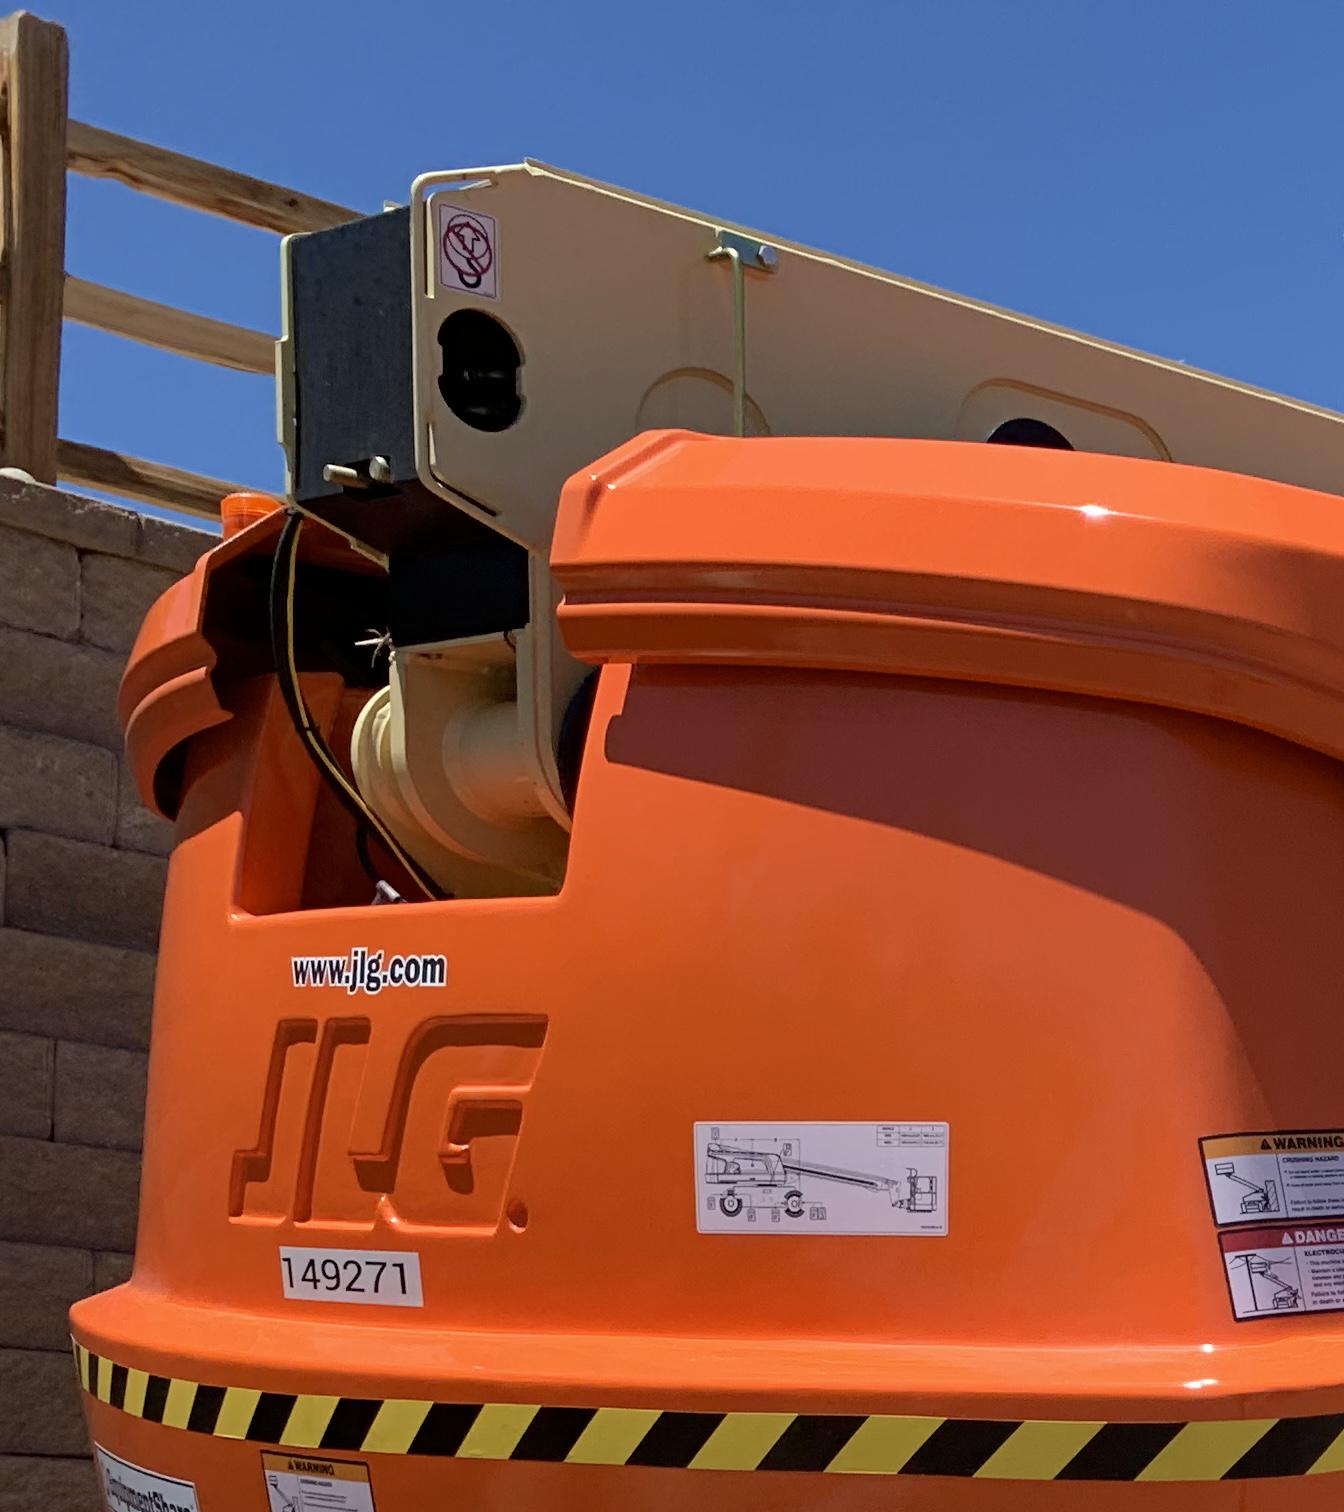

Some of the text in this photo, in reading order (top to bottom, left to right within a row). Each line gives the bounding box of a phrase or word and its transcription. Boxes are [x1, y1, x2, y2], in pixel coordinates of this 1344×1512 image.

[292, 948, 447, 994] www.jlg.com
[228, 1013, 549, 1237] JLG
[1272, 1136, 1344, 1151] WARNING
[281, 1256, 408, 1296] 149271
